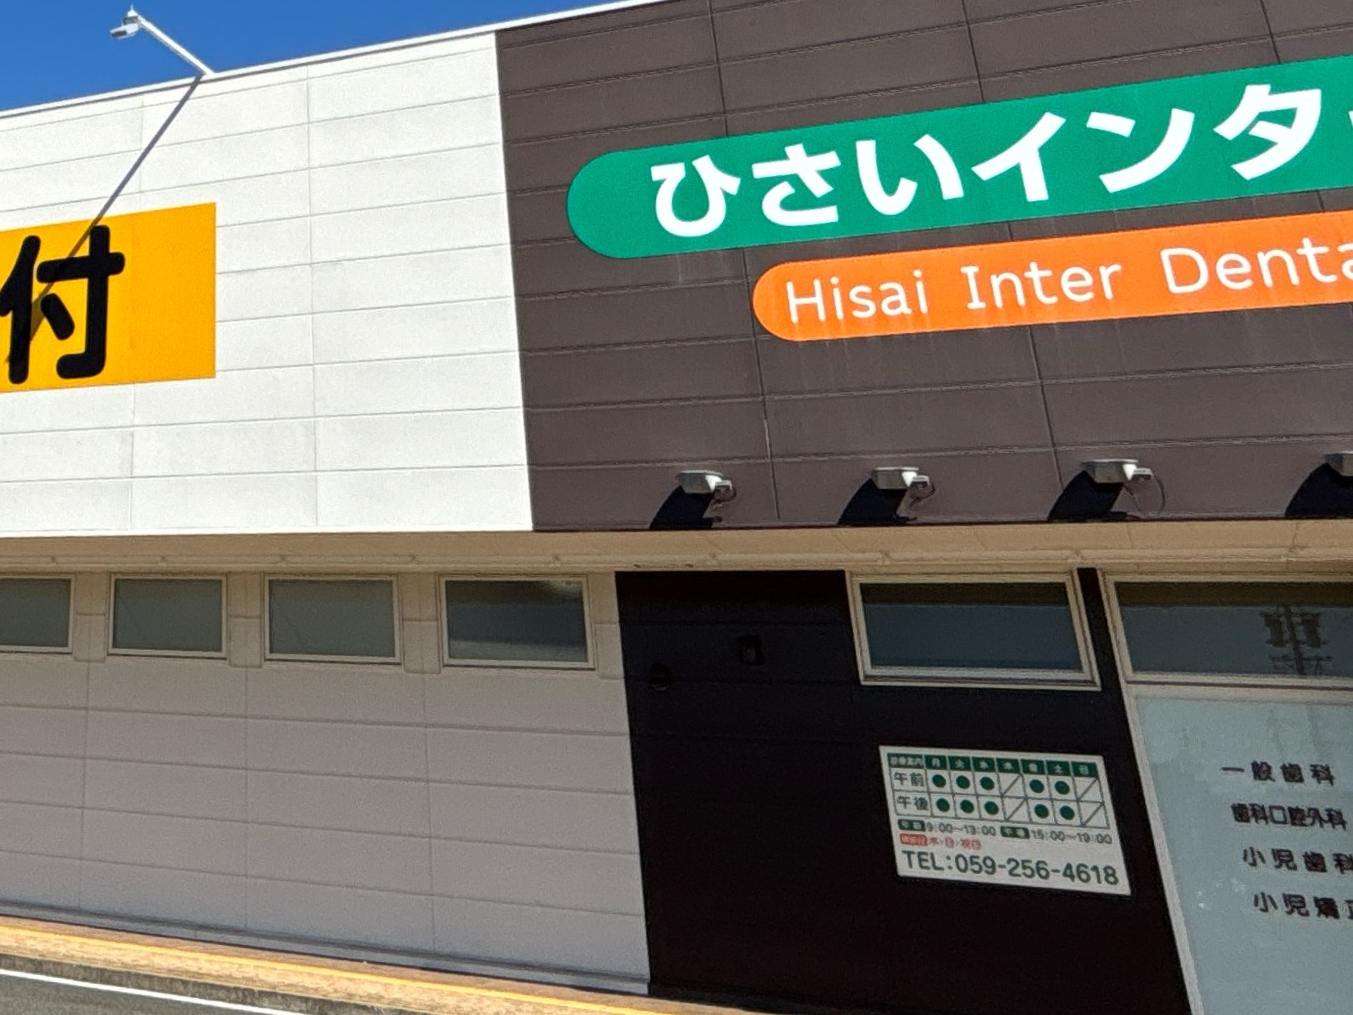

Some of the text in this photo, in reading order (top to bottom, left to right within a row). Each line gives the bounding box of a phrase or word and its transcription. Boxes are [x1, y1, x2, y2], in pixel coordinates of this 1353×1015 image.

[649, 82, 1353, 239] ひさいインタ
[785, 268, 931, 326] Hisai
[966, 259, 1123, 311] Inter
[893, 771, 924, 787] 午前
[1221, 760, 1336, 786] 一般歯科
[896, 794, 929, 811] 午後
[1231, 802, 1347, 831] 歯科口腔外科
[901, 849, 1120, 886] TEL:059-256-4618
